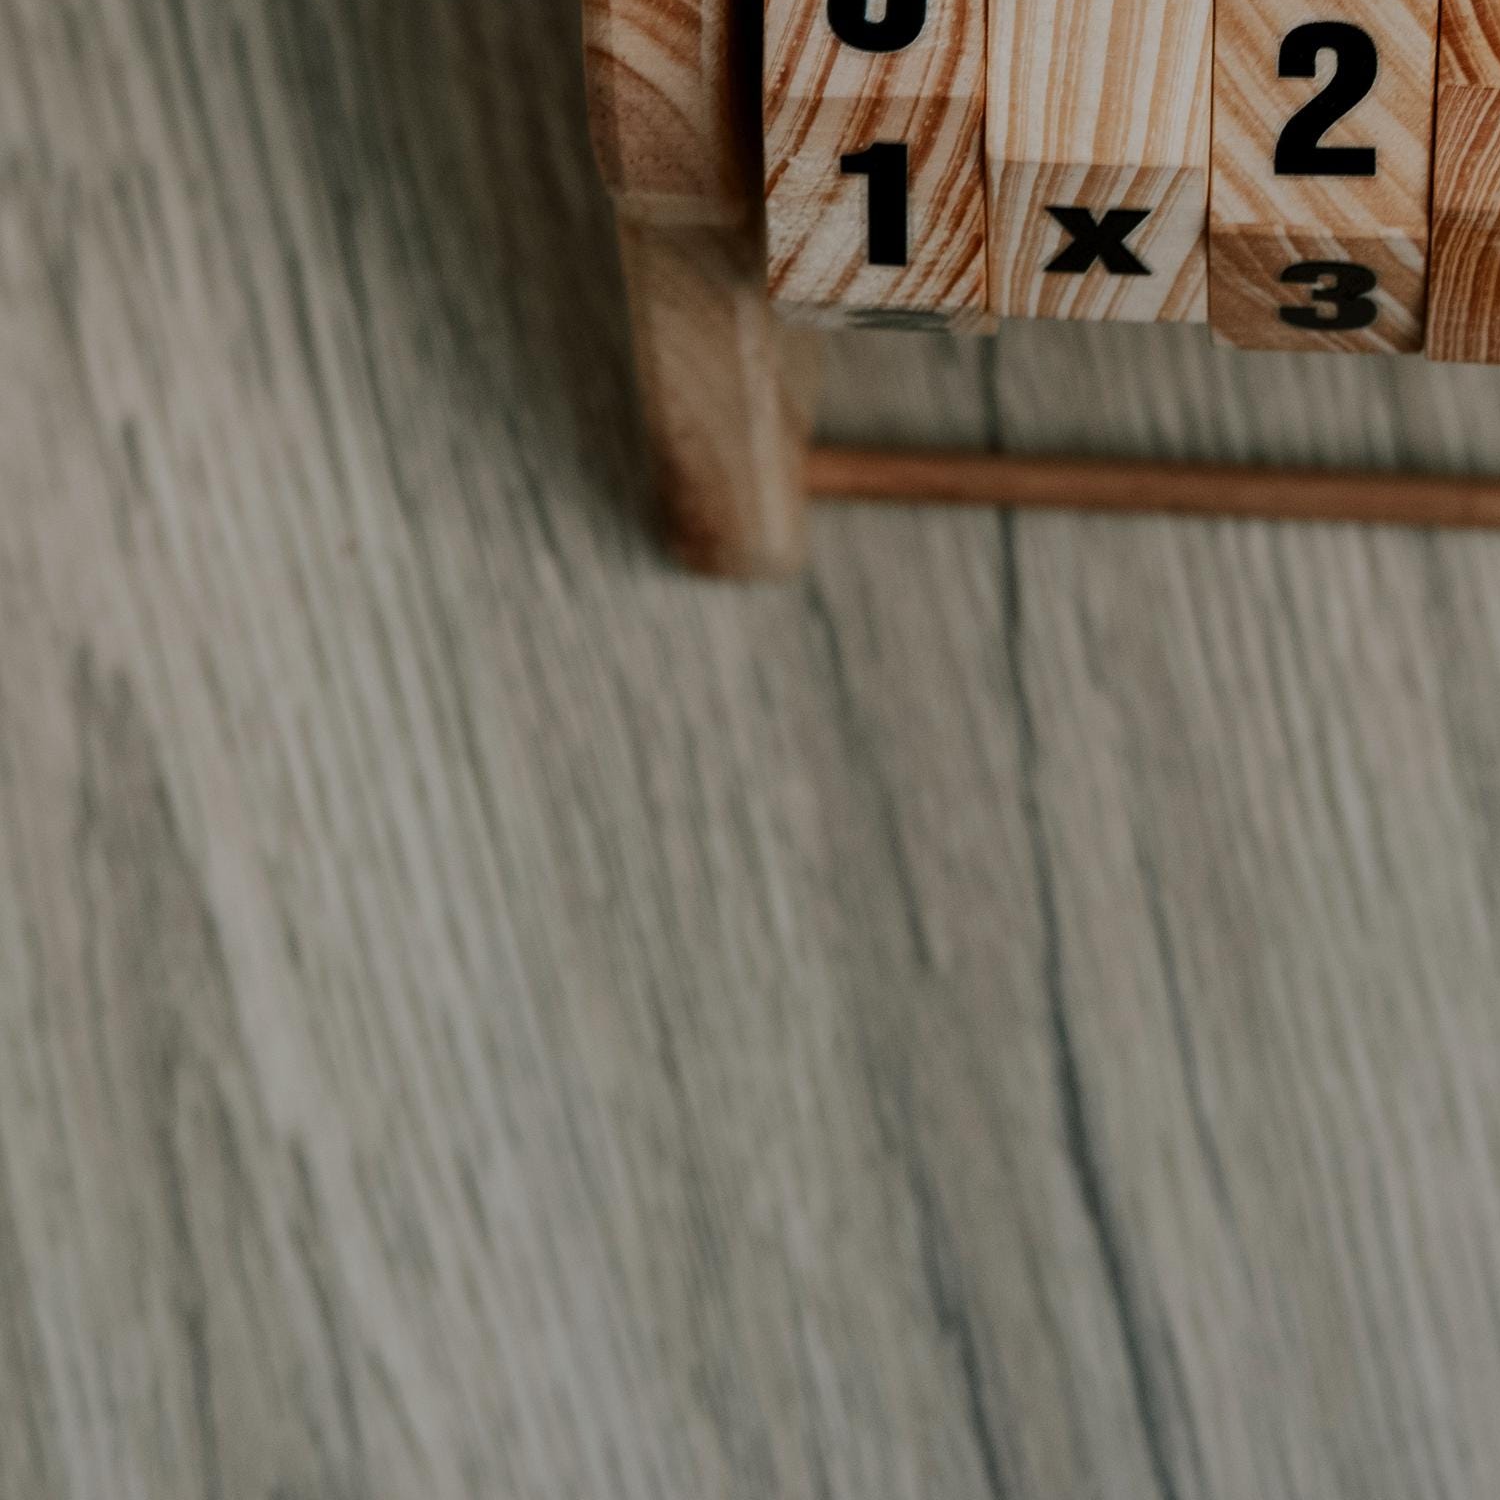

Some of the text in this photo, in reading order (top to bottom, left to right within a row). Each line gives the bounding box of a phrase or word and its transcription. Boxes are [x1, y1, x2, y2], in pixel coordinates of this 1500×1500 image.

[1273, 21, 1378, 176] 2
[838, 142, 908, 267] 1
[1279, 260, 1378, 330] 3
